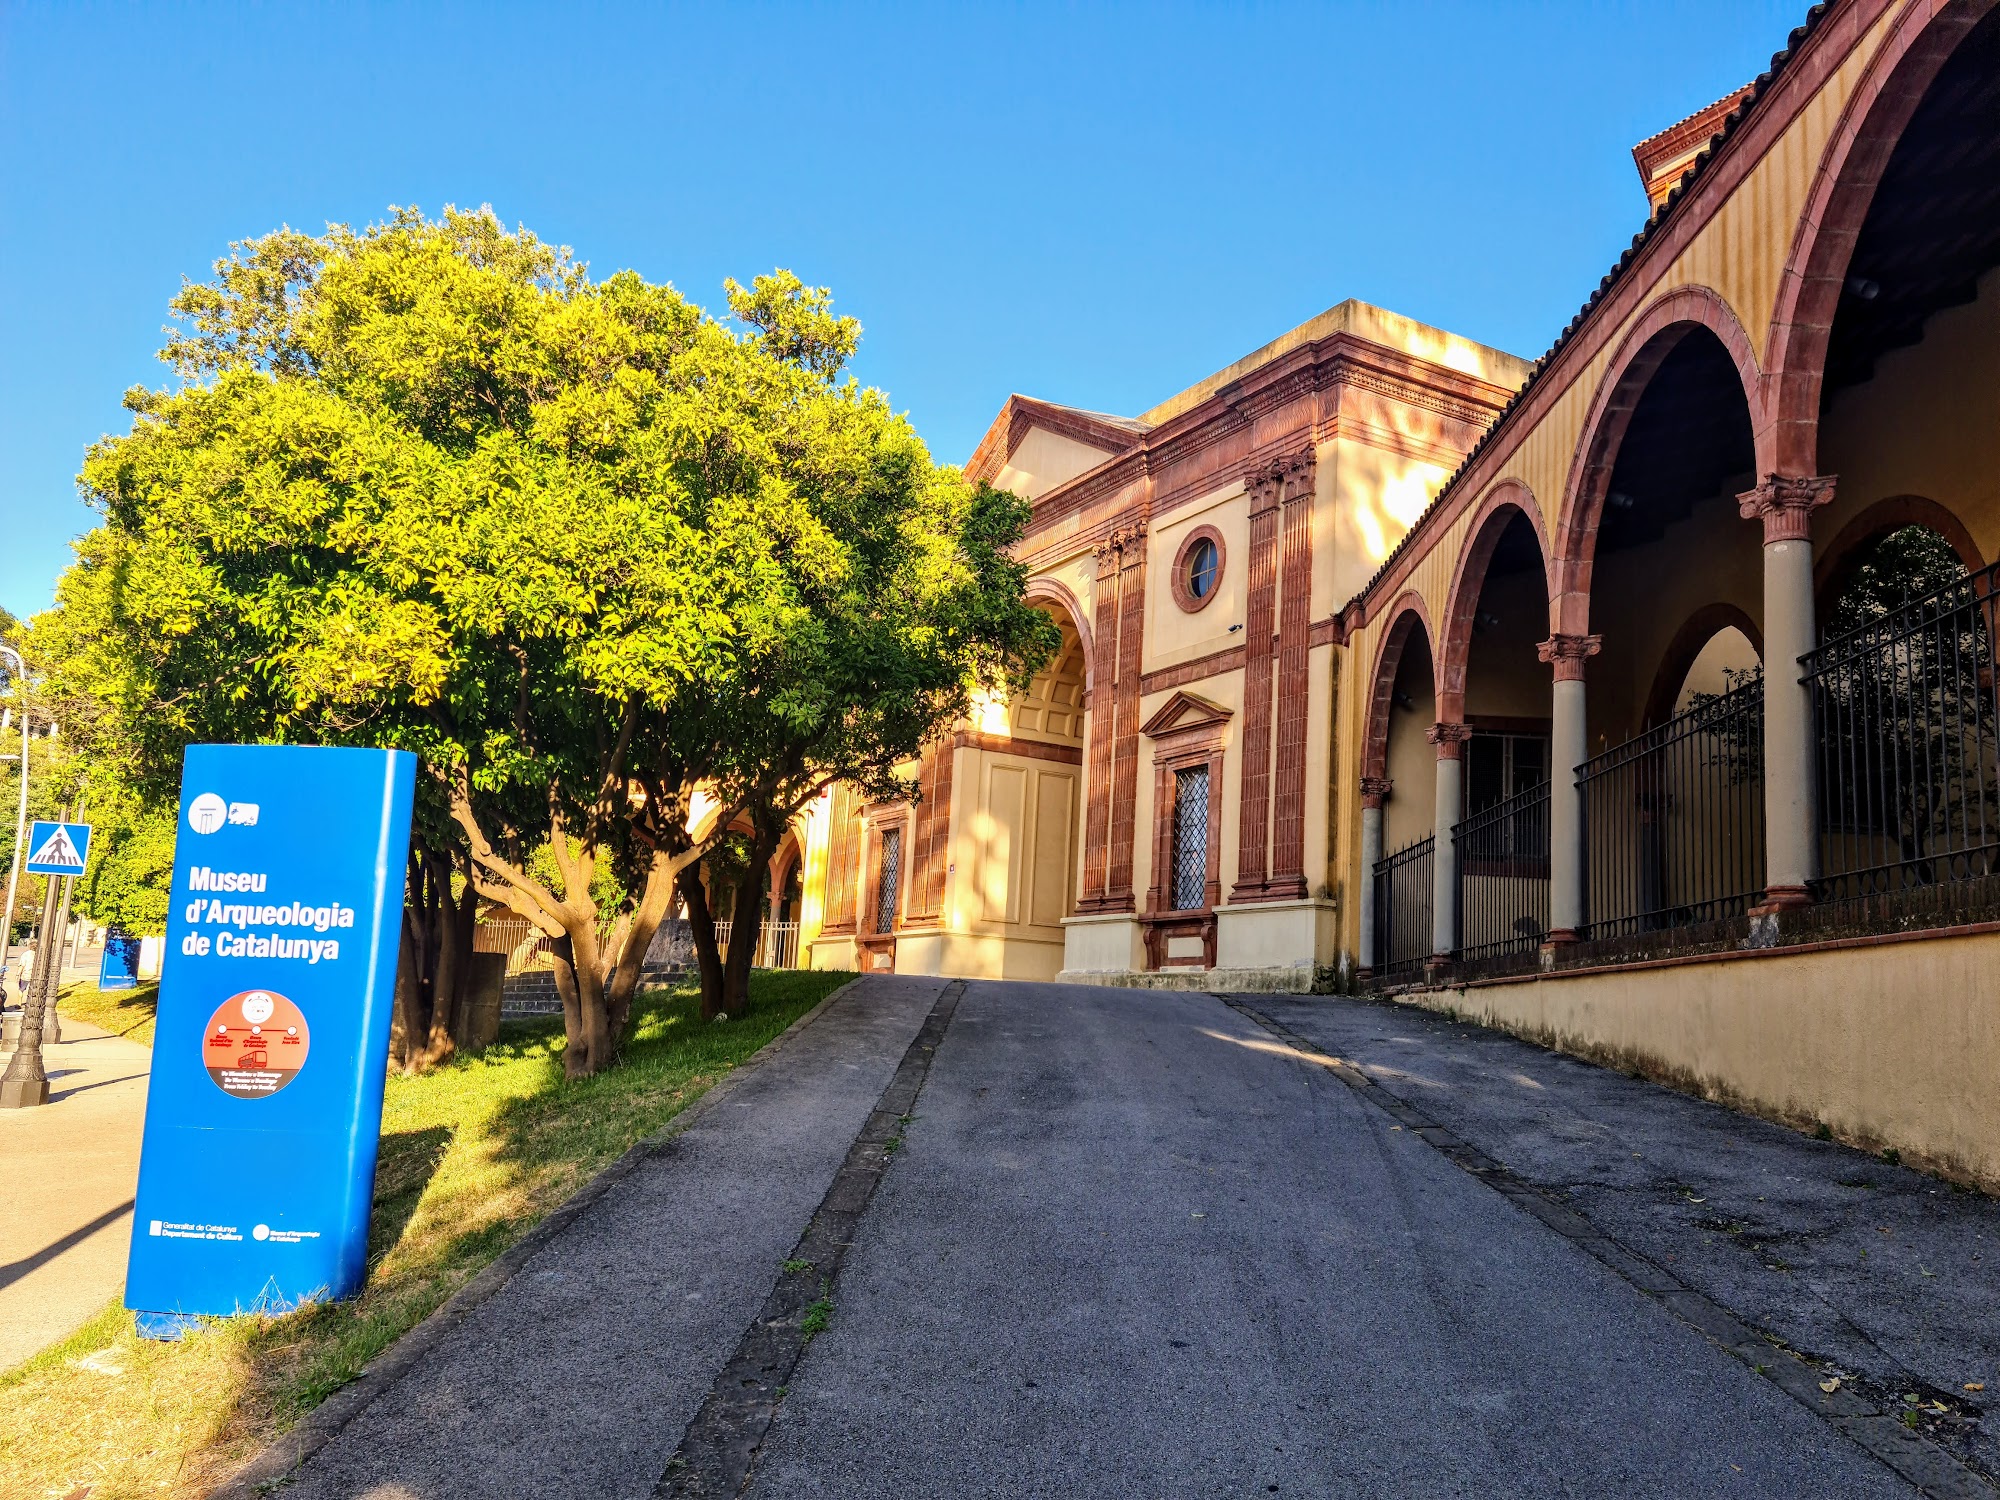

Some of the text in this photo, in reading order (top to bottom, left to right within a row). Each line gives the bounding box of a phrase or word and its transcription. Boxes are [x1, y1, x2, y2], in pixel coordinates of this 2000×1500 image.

[189, 867, 267, 893] Museu
[186, 899, 354, 932] d'Arqueologia
[182, 932, 340, 965] de Catalunya
[206, 1225, 236, 1234] Catalunya
